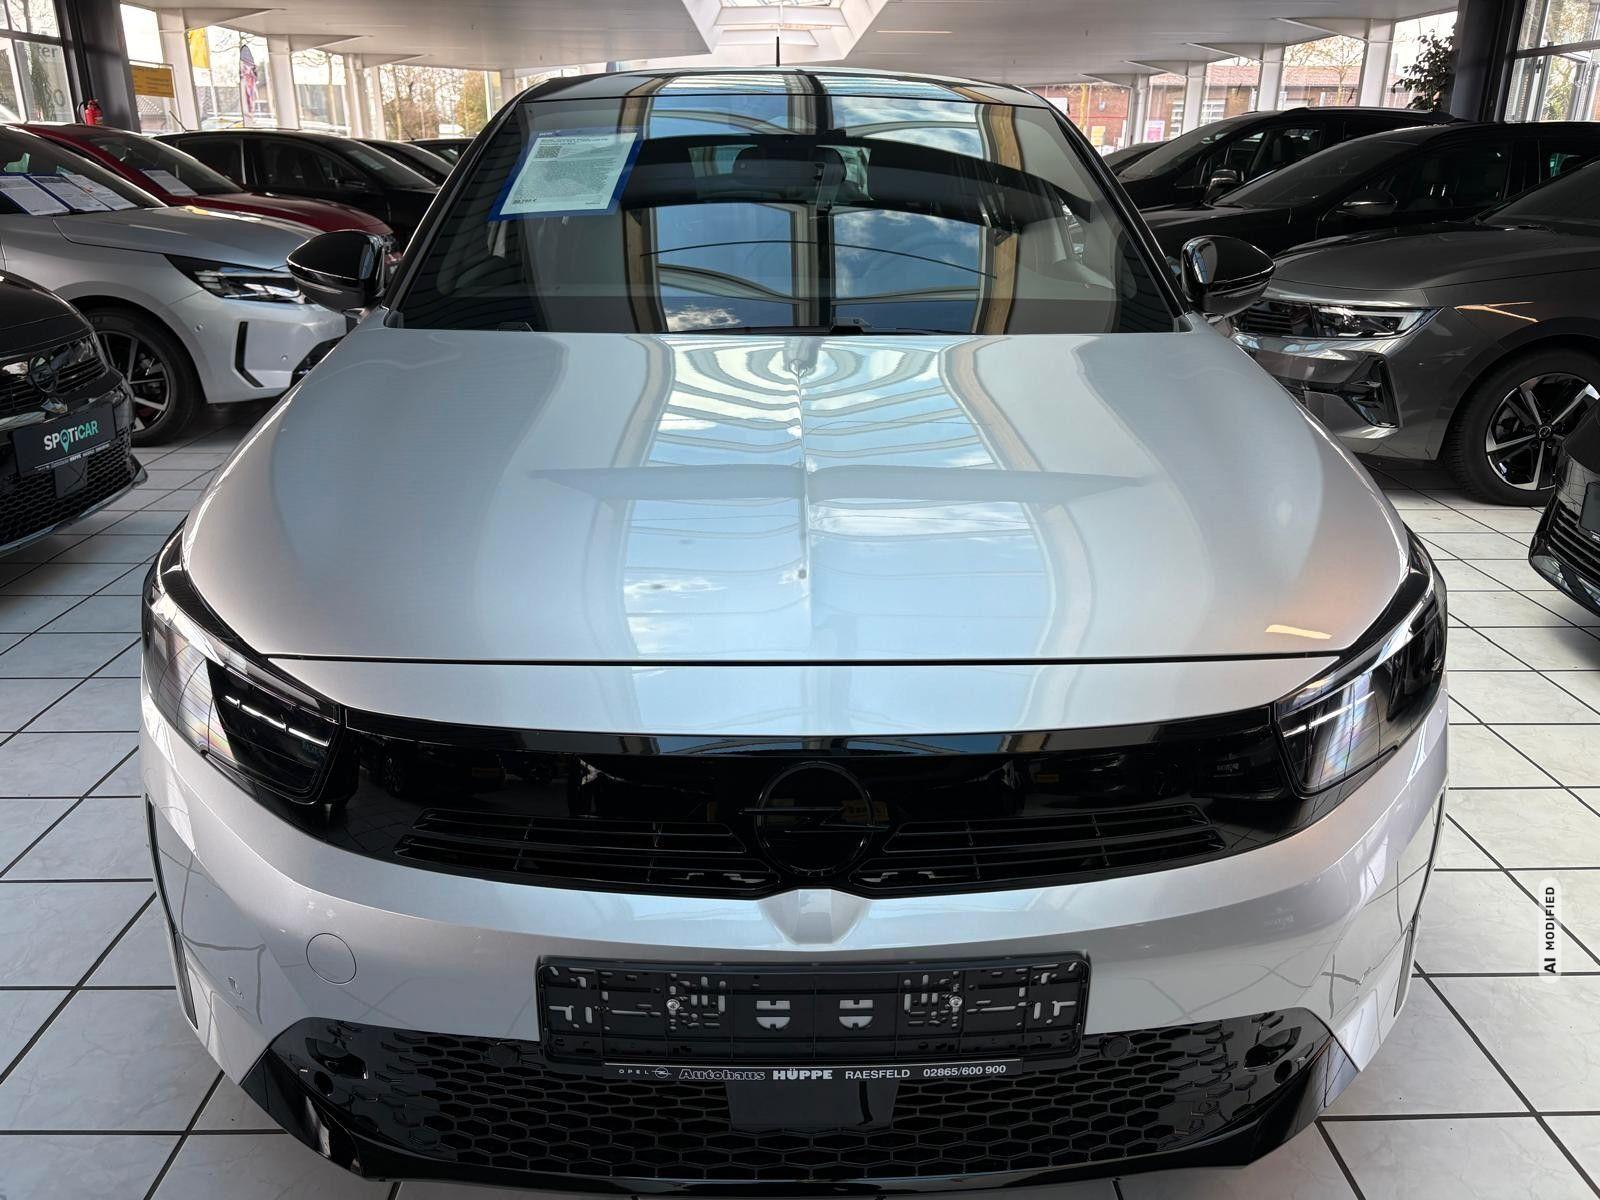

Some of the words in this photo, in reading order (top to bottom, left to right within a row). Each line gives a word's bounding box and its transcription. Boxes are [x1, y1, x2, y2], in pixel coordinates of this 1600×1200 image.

[678, 1068, 766, 1080] Autohaus
[772, 1067, 833, 1080] HÜPPE
[845, 1069, 910, 1079] RAESFELD
[923, 1066, 983, 1077] 02865/600
[985, 1065, 1007, 1074] 900
